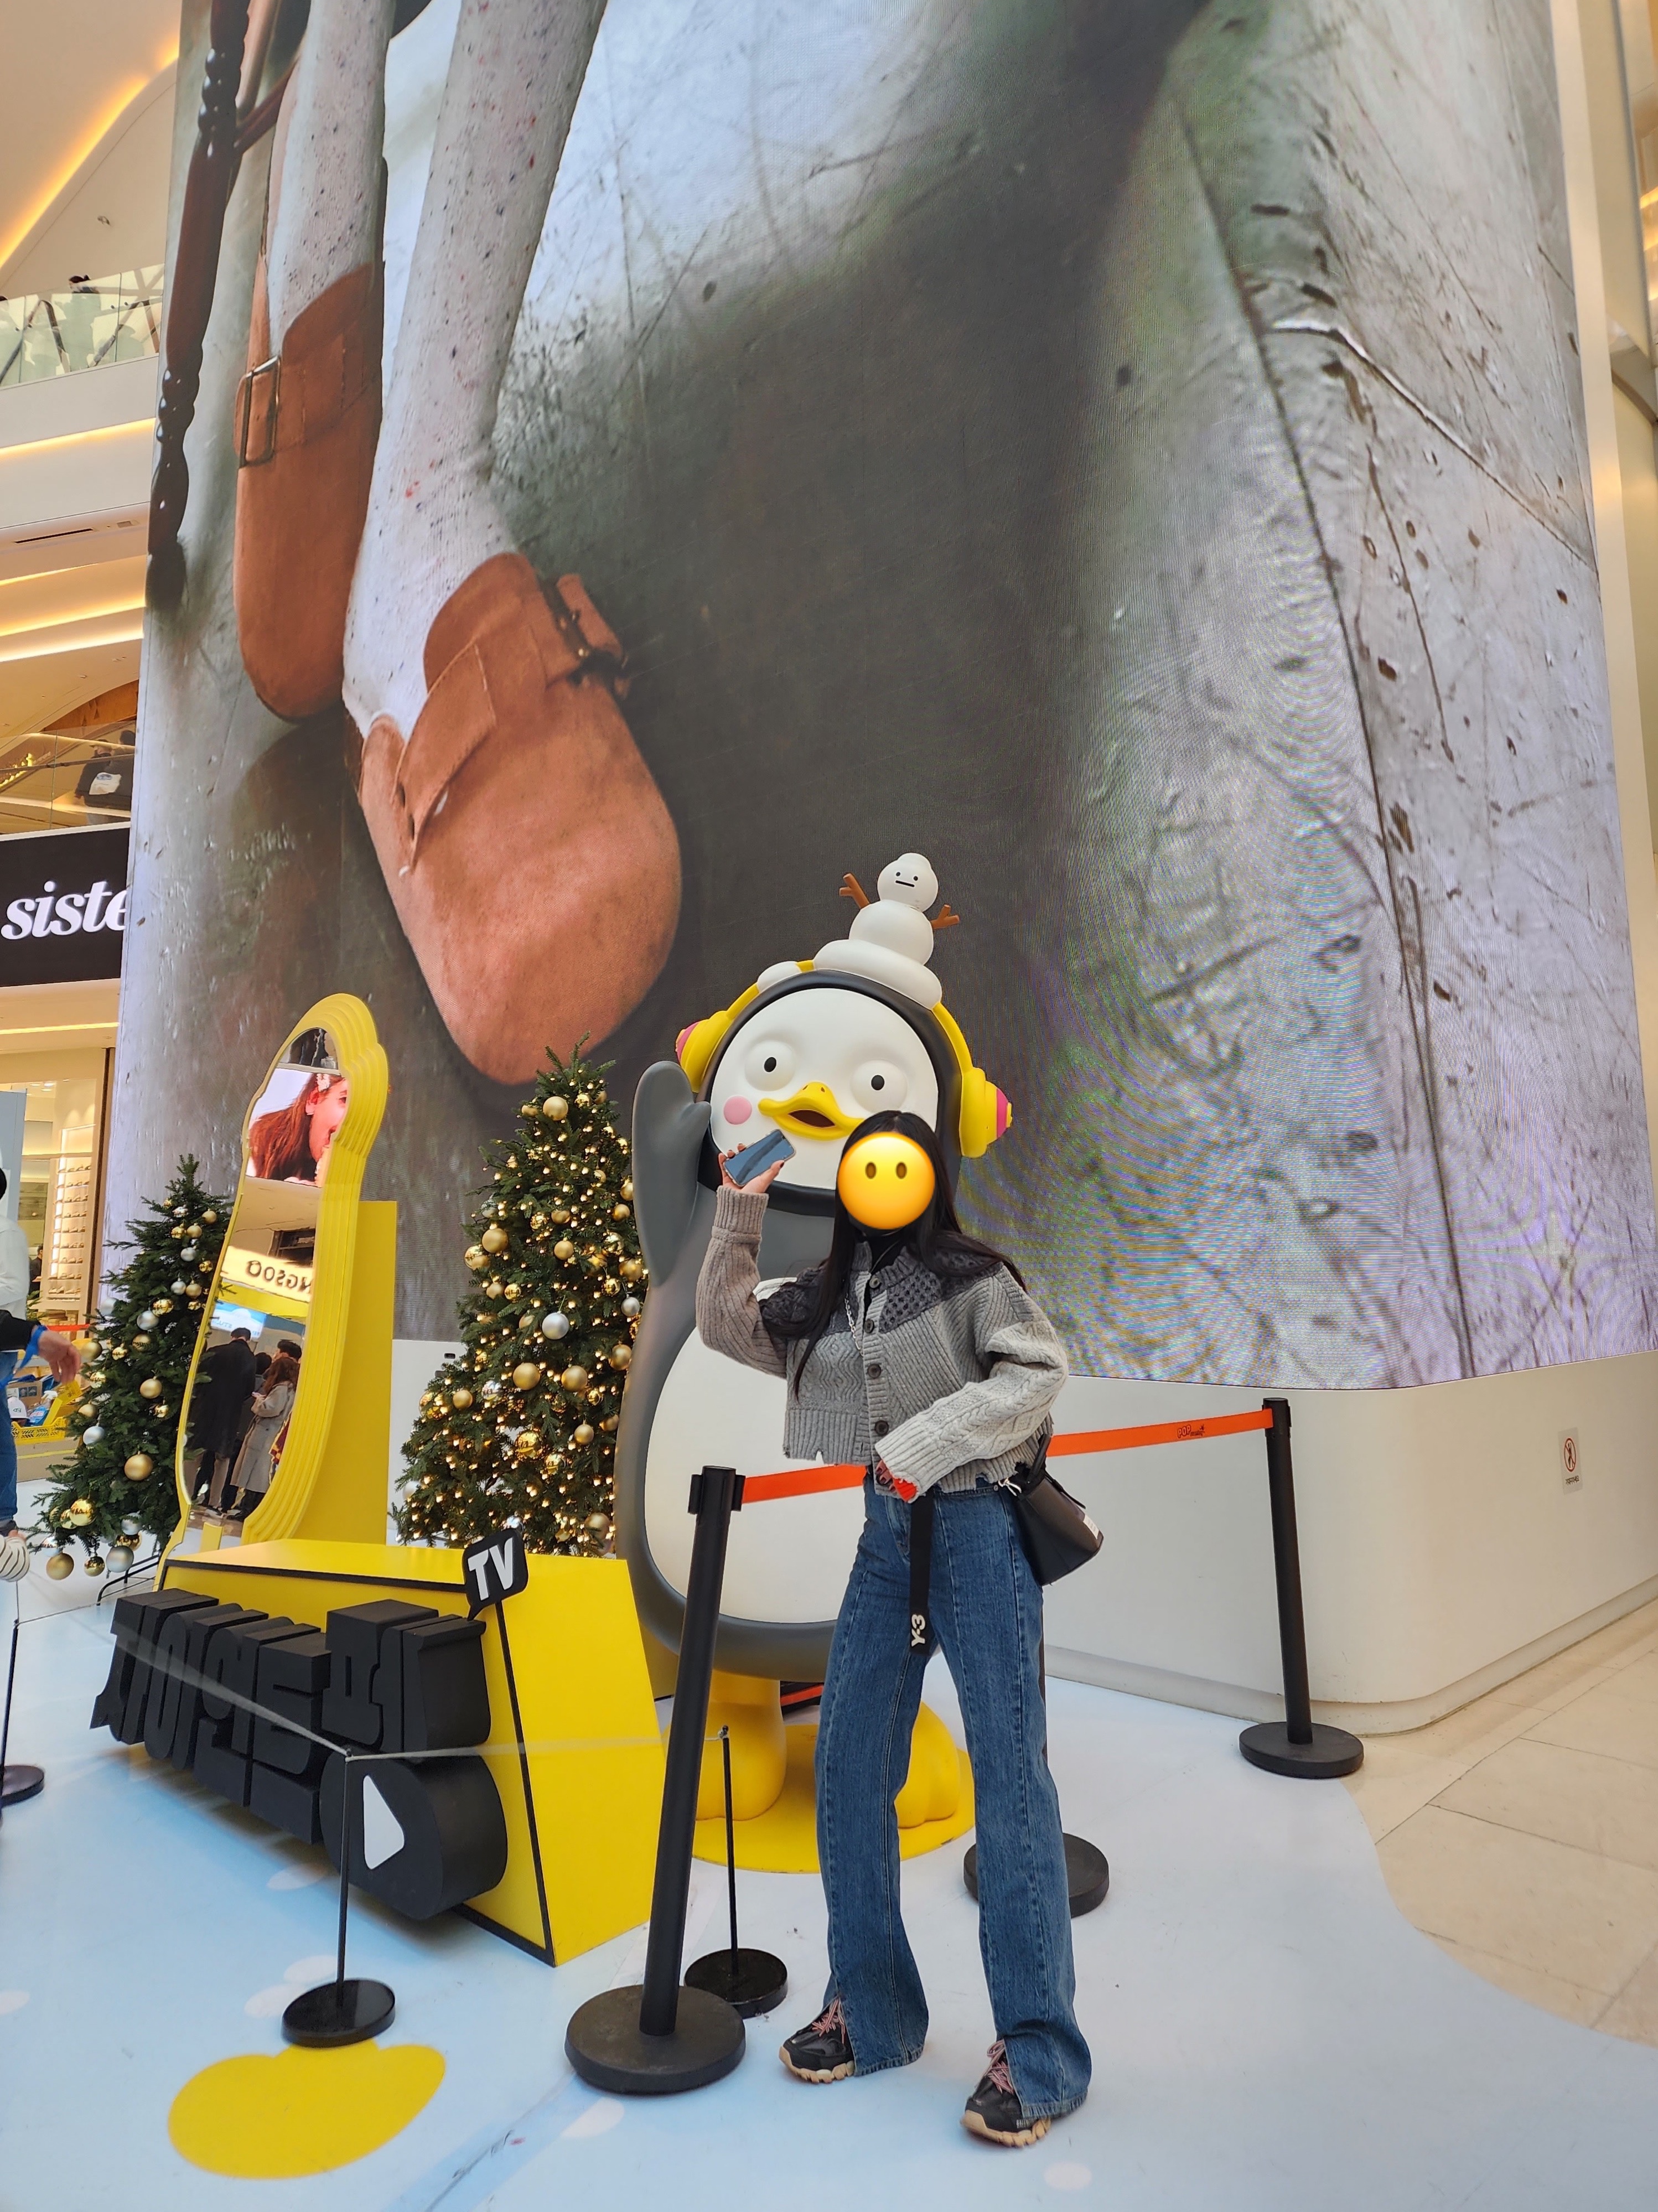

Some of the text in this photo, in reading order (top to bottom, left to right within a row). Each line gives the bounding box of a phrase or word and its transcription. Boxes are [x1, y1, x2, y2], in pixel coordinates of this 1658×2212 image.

[1177, 1424, 1191, 1438] POP
[468, 1537, 513, 1600] TV
[911, 1614, 925, 1647] Y-3
